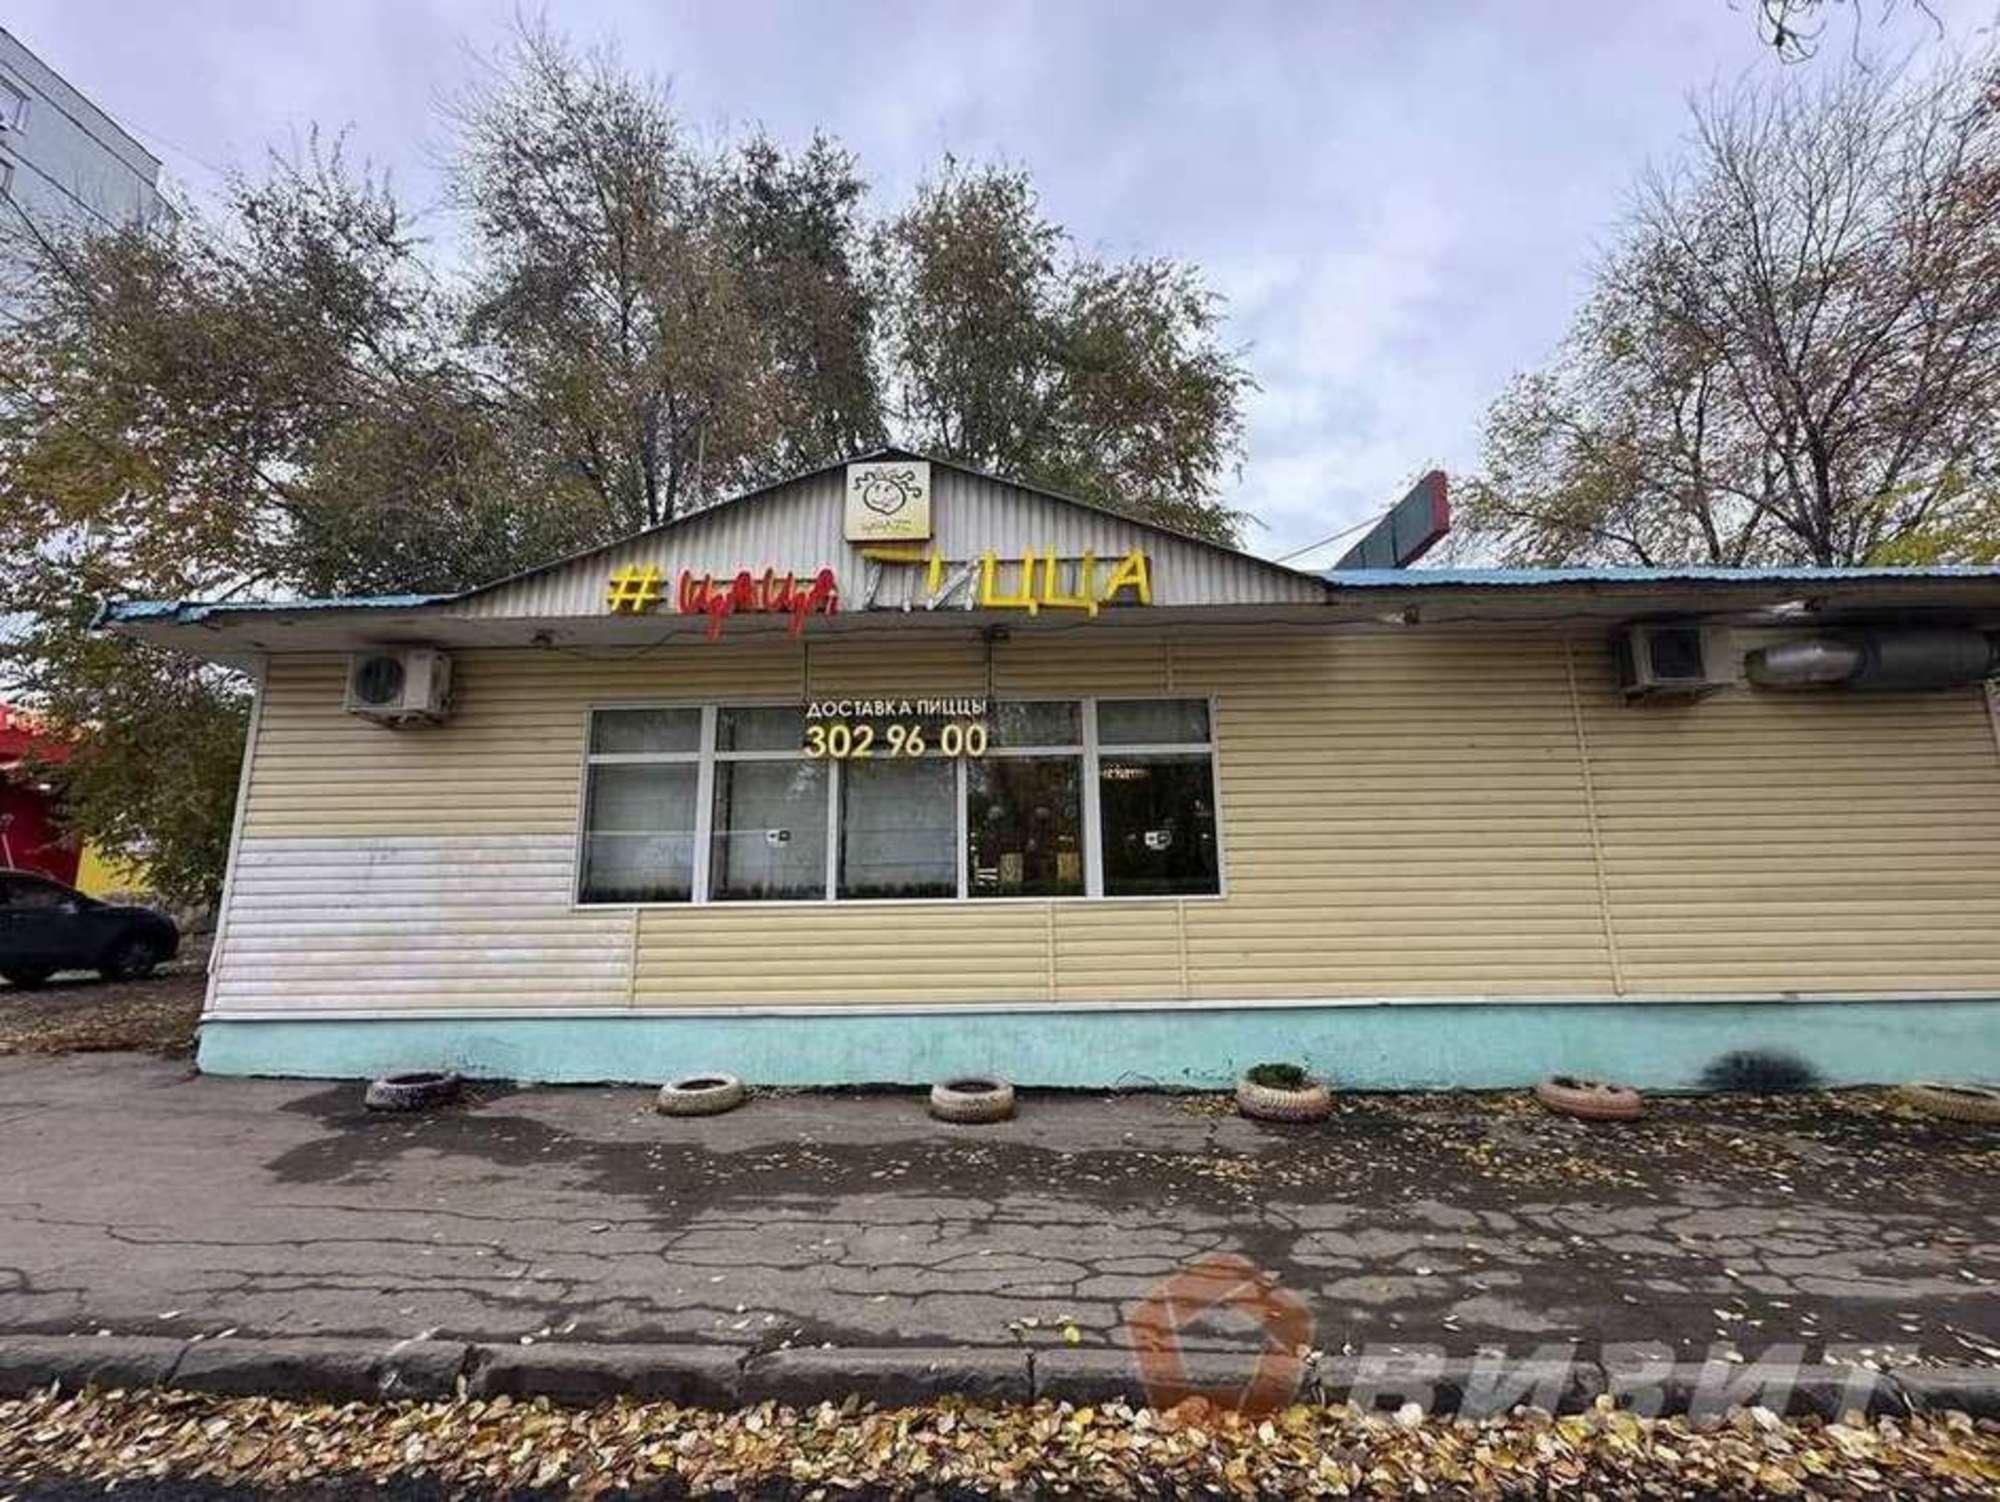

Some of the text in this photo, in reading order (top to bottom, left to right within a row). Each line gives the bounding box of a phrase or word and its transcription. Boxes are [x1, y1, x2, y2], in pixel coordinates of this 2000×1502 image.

[806, 700, 987, 718] ДОСТАВКА ПИЦЦЫ
[804, 723, 987, 758] 302 96 00
